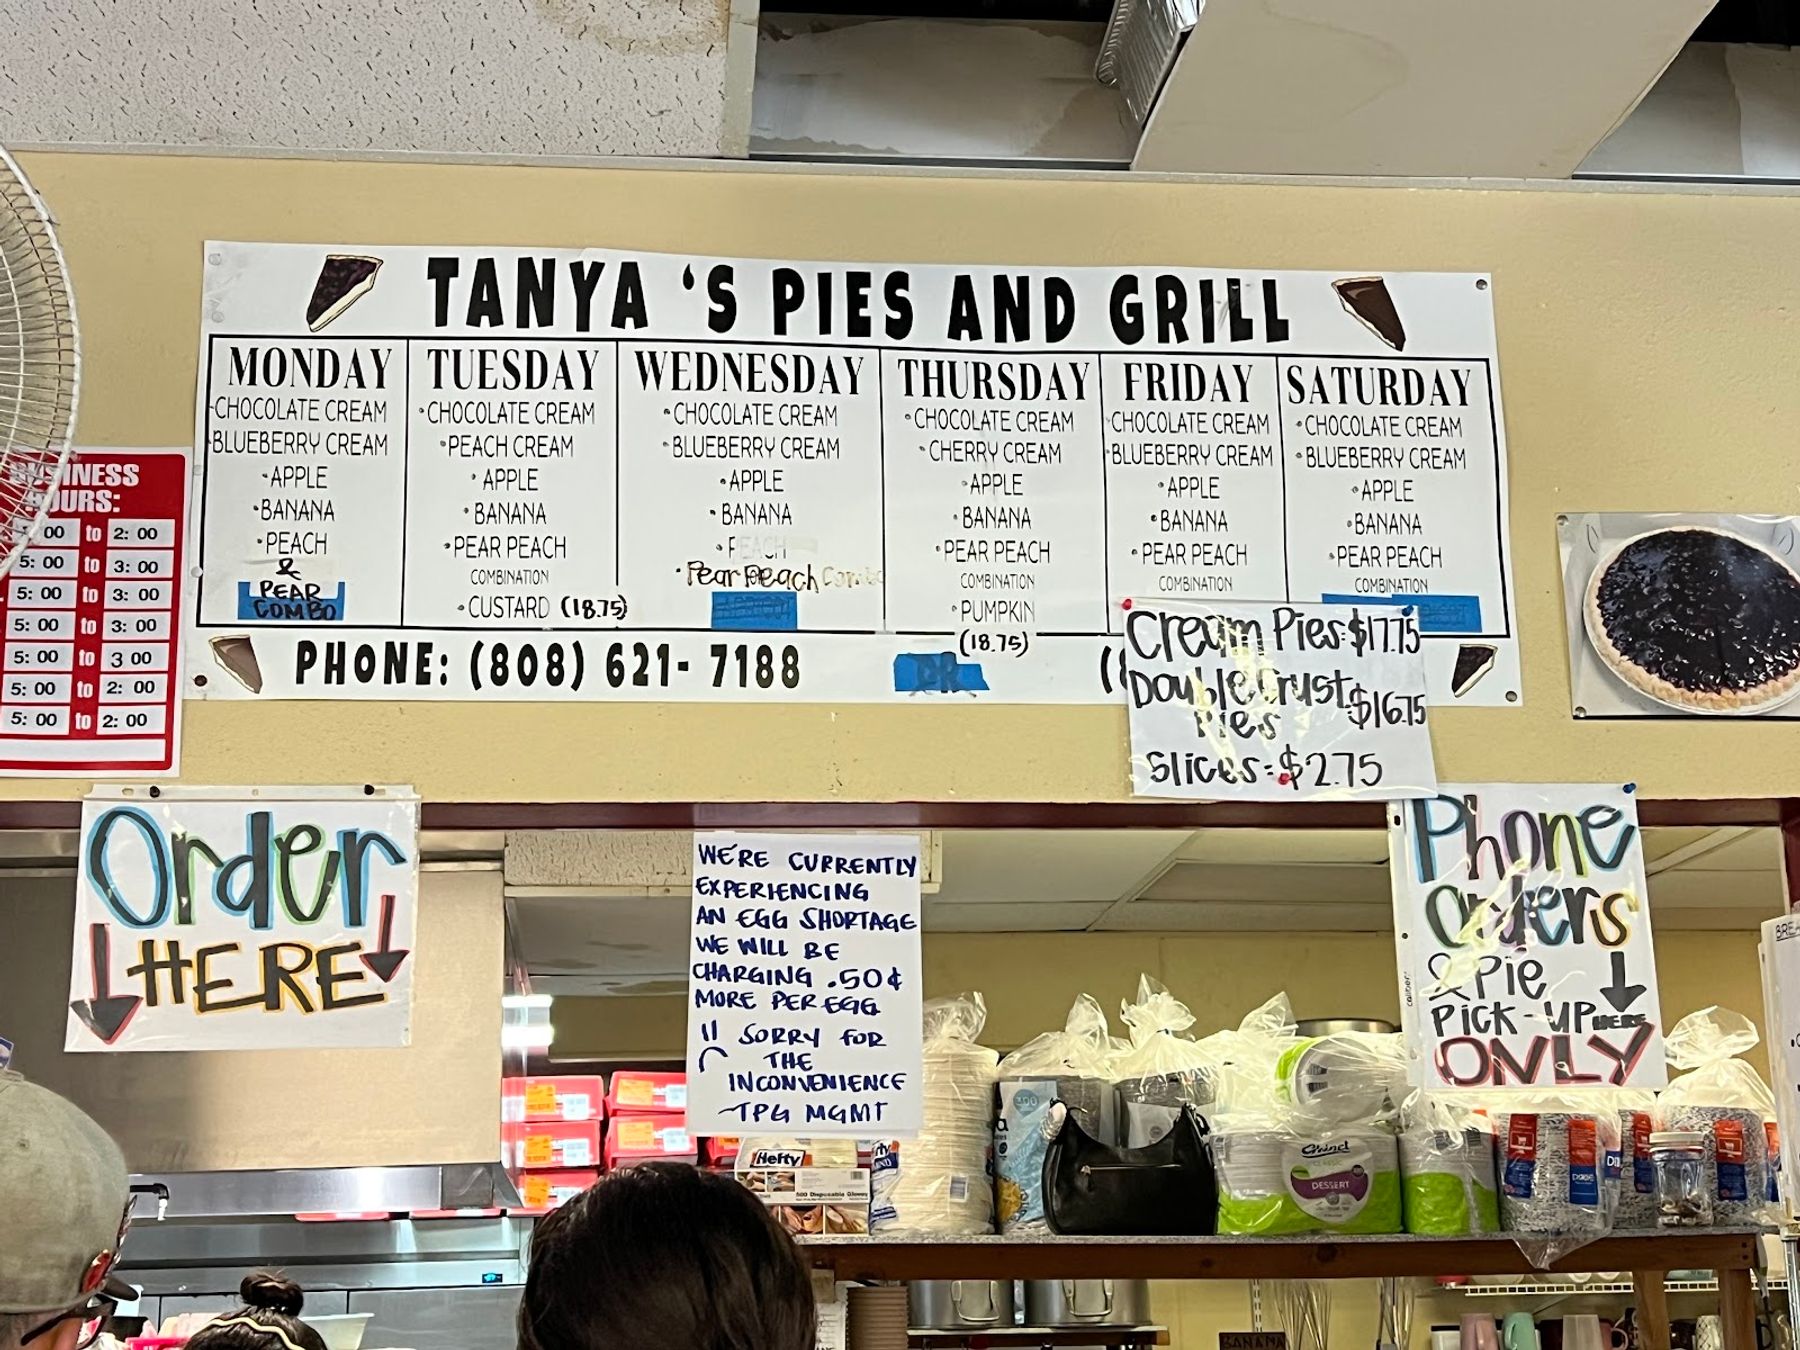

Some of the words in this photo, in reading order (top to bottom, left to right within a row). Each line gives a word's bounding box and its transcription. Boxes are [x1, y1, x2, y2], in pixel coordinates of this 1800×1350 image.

[427, 256, 648, 332] TANYA
[772, 267, 913, 341] PIES
[947, 274, 1075, 343] AND
[1109, 274, 1290, 346] GRILL
[228, 346, 393, 390] MONDAY
[427, 348, 599, 391] TUESDAY
[634, 350, 864, 395] WEDNESDAY
[898, 358, 1090, 401] THURSDAY
[1123, 362, 1253, 403] FRIDAY
[1286, 365, 1471, 407] SATURDAY
[214, 396, 319, 422] CHOCOLATE
[325, 399, 387, 423] CREAM
[428, 400, 532, 425] CHOCOLATE
[535, 402, 595, 425] CREAM
[673, 402, 774, 426] CHOCOLATE
[778, 404, 838, 427] CREAM
[914, 407, 1011, 431] CHOCOLATE
[1015, 410, 1074, 433] CREAM
[1111, 411, 1207, 434] CHOCOLATE
[1212, 413, 1270, 434] CREAM
[1304, 415, 1400, 437] CHOCOLATE
[1405, 416, 1463, 438] CREAM
[212, 430, 320, 454] BLUEBERRY
[325, 432, 388, 456] CREAM
[448, 435, 508, 458] PEACH
[513, 436, 574, 459] CREAM
[673, 434, 775, 458] BLUEBERRY
[780, 436, 840, 459] CREAM
[929, 439, 998, 463] CHERRY
[1003, 441, 1061, 464] CREAM
[1112, 443, 1210, 466] BLUEBERRY
[1215, 445, 1273, 467] CREAM
[1306, 446, 1404, 469] BLUEBERRY
[1409, 447, 1466, 470] CREAM
[270, 465, 328, 489] APPLE
[483, 468, 538, 491] APPLE
[729, 469, 784, 493] APPLE
[970, 473, 1023, 496] APPLE
[1167, 476, 1220, 499] APPLE
[1361, 479, 1414, 502] APPLE
[261, 499, 335, 522] BANANA
[474, 502, 547, 526] BANANA
[722, 502, 792, 526] BANANA
[963, 506, 1032, 529] BANANA
[1160, 509, 1228, 533] BANANA
[86, 525, 101, 542] to
[113, 528, 129, 540] 2:
[137, 527, 158, 541] 00
[1354, 513, 1422, 535] BANANA
[266, 531, 327, 555] PEACH
[454, 536, 501, 559] PEAR
[507, 536, 566, 560] PEACH
[943, 540, 989, 563] PEAR
[994, 540, 1050, 563] PEACH
[1142, 543, 1186, 566] PEAR
[1191, 543, 1248, 566] PEACH
[18, 556, 35, 568] 5:
[43, 556, 64, 569] 00
[84, 556, 100, 572] to
[113, 560, 130, 573] 3:
[137, 560, 158, 574] 00
[1337, 545, 1381, 568] PEAR
[1386, 545, 1442, 569] PEACH
[470, 568, 549, 586] COMBINATION
[960, 573, 1035, 590] COMBINATION
[1158, 575, 1233, 592] COMBINATION
[1354, 577, 1428, 593] COMBINATION
[17, 587, 32, 599] 5:
[41, 586, 62, 600] 00
[82, 586, 98, 603] to
[112, 588, 129, 601] 3:
[138, 587, 159, 601] 00
[260, 581, 321, 600] PEAR
[253, 600, 336, 620] COMBO
[468, 596, 550, 619] CUSTARD
[561, 595, 628, 621] (18.75)
[961, 600, 1035, 623] PUMPKIN
[14, 618, 30, 631] 5:
[38, 618, 59, 631] 00
[80, 617, 96, 635] to
[111, 620, 127, 632] 3:
[135, 618, 157, 632] 00
[1126, 610, 1265, 662] Cream
[959, 629, 1029, 658] (18.75)
[14, 650, 29, 663] 5:
[37, 650, 58, 663] 00
[79, 649, 95, 666] to
[110, 652, 123, 668] 3
[131, 651, 152, 665] 00
[296, 640, 448, 686] PHONE:
[470, 640, 584, 691] (808)
[606, 643, 689, 688] 621-
[710, 644, 800, 689] 7188
[11, 682, 27, 695] 5:
[34, 681, 55, 695] 00
[77, 680, 93, 698] to
[106, 681, 122, 694] 2:
[134, 680, 155, 694] 00
[1128, 666, 1255, 708] Double
[11, 711, 27, 725] 5:
[35, 713, 57, 726] 00
[75, 711, 91, 729] to
[102, 714, 118, 728] 2:
[126, 713, 147, 727] 00
[1277, 744, 1383, 790] $2.75
[1413, 794, 1638, 883] Phone
[86, 806, 408, 930] Order
[788, 852, 917, 878] CURRENTLY
[695, 877, 869, 901] EXPERIENCING
[696, 905, 726, 926] AN
[735, 908, 788, 930] EGG
[799, 907, 918, 933] SHORTAGE
[696, 935, 728, 955] WE
[737, 937, 789, 957] WILL
[803, 942, 840, 961] BE
[126, 938, 389, 1015] HERE
[692, 962, 813, 988] CHARGING
[695, 989, 757, 1011] MORE
[771, 990, 817, 1012] PER
[820, 997, 881, 1016] EGG
[738, 1023, 820, 1048] SORRY
[762, 1051, 813, 1071] THE
[1434, 1022, 1657, 1087] ONLY
[728, 1071, 907, 1093] INCONVENIENCE
[805, 1101, 889, 1124] MGMT
[756, 1151, 801, 1167] Hefty
[1311, 1180, 1350, 1191] DESSERT
